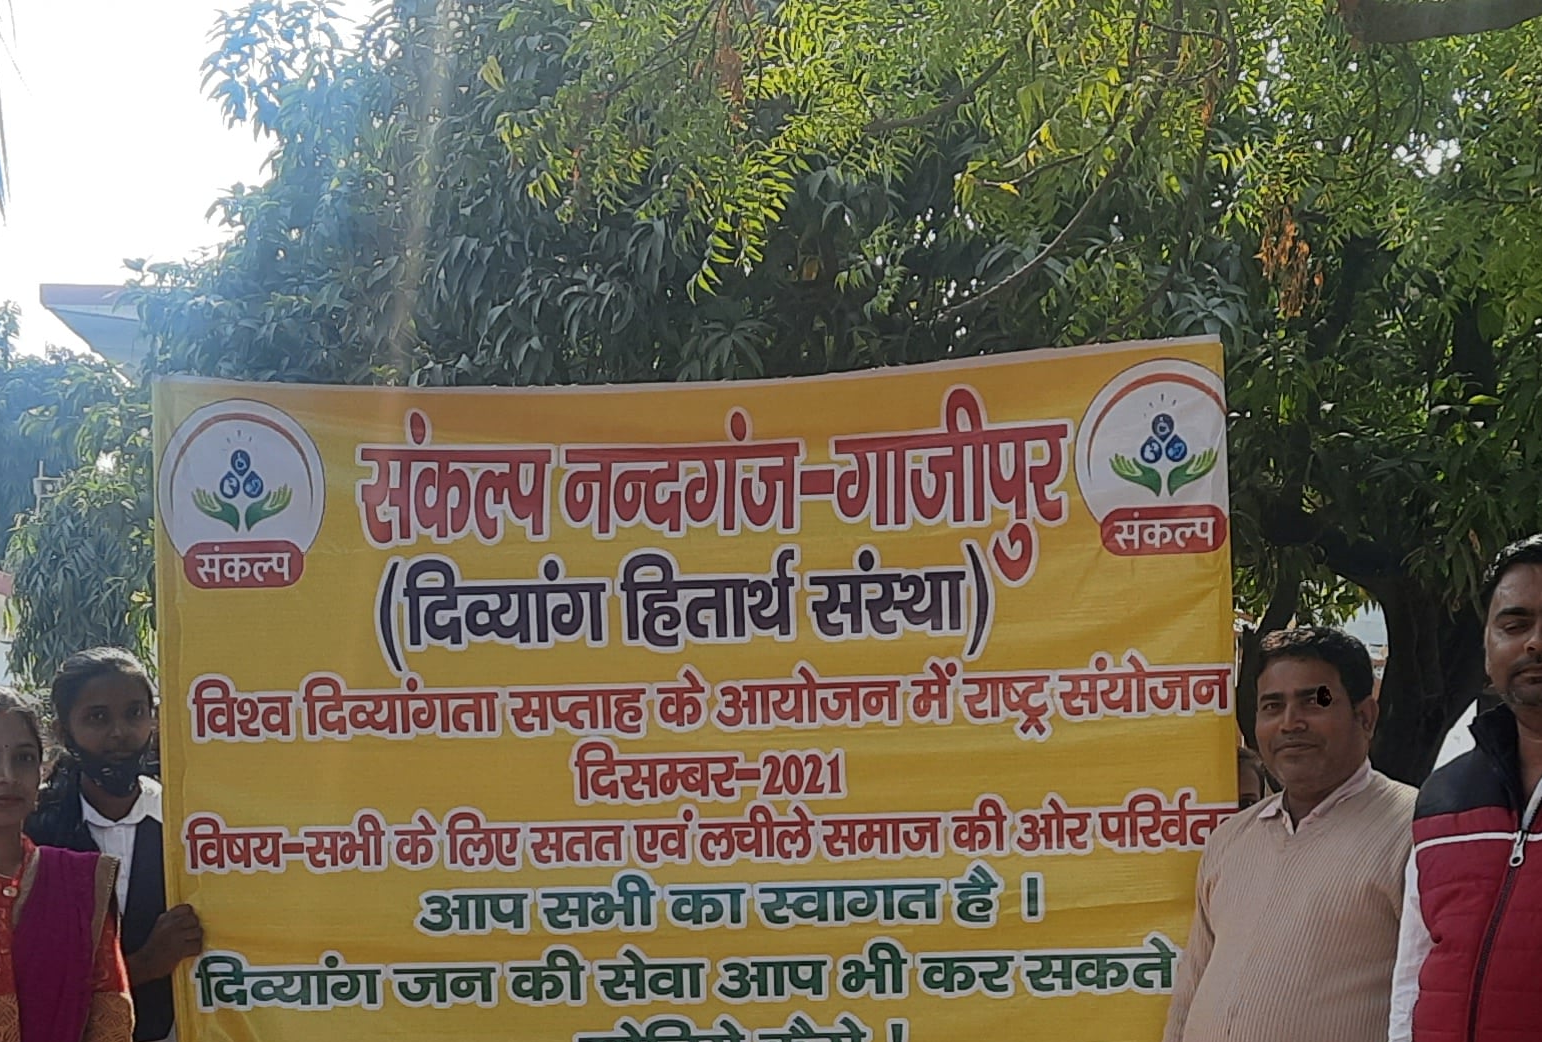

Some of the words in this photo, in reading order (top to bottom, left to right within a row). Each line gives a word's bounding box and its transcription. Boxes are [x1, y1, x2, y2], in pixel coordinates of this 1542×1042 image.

[361, 411, 552, 544] संकल्प
[564, 388, 1068, 582] नन्दगंज-गाजीपुर
[196, 545, 291, 584] संकल्प
[1114, 512, 1216, 551] संकल्प
[379, 558, 606, 672] (दिव्यांग
[620, 548, 795, 647] हितार्थ
[809, 543, 990, 656] संस्था)
[192, 678, 293, 738] विश्व
[302, 676, 499, 736] दिव्यांगता
[508, 686, 647, 734] सप्ताह
[656, 669, 706, 728] के
[716, 665, 901, 728] आयोजन
[910, 661, 958, 721] में
[961, 674, 1051, 736] राष्ट्र
[1058, 654, 1232, 716] संयोजन
[574, 740, 842, 801] दिसम्बर-2021
[185, 813, 386, 870] विषय-सभी
[394, 814, 437, 866] के
[445, 811, 521, 867] लिए
[529, 824, 626, 863] सतत
[633, 808, 694, 863] एवं
[698, 804, 816, 861] लचीले
[822, 815, 942, 856] समाज
[951, 798, 1007, 853] की
[1016, 797, 1092, 852] ओर
[419, 892, 529, 932] आप
[541, 874, 657, 930] सभी
[668, 888, 746, 926] का
[759, 882, 942, 926] स्वागत
[954, 864, 999, 923] है
[195, 954, 382, 1008] दिव्यांग
[392, 966, 497, 1004] जन
[509, 948, 586, 1002] की
[598, 948, 706, 1001] सेवा
[717, 959, 827, 998] आप
[841, 941, 909, 996] भी
[920, 955, 1015, 993] कर
[1024, 936, 1177, 991] सकते
